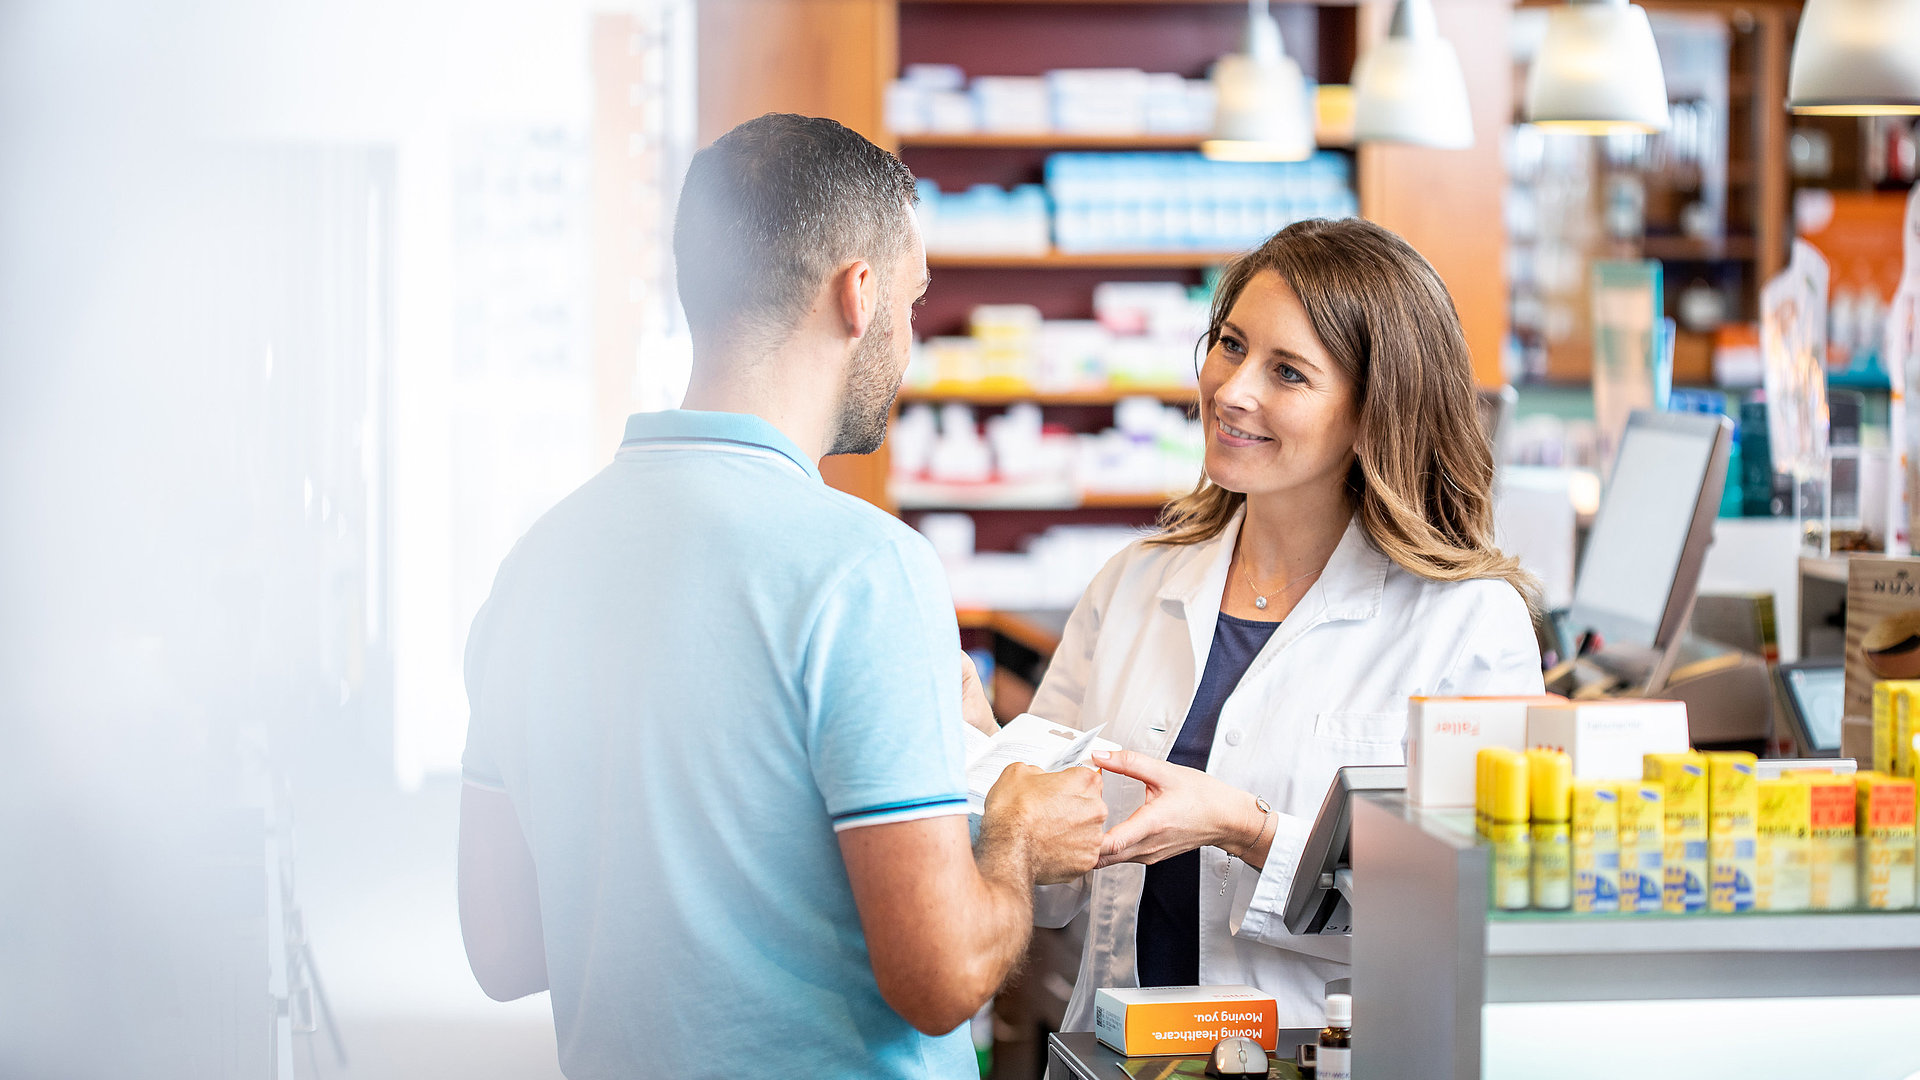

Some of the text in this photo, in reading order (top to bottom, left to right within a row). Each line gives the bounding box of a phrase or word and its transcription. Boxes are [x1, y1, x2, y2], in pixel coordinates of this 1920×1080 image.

[1874, 580, 1920, 594] NUX
[1193, 1011, 1263, 1024] Moving you.
[1151, 1027, 1263, 1041] Moving Healthcare.
